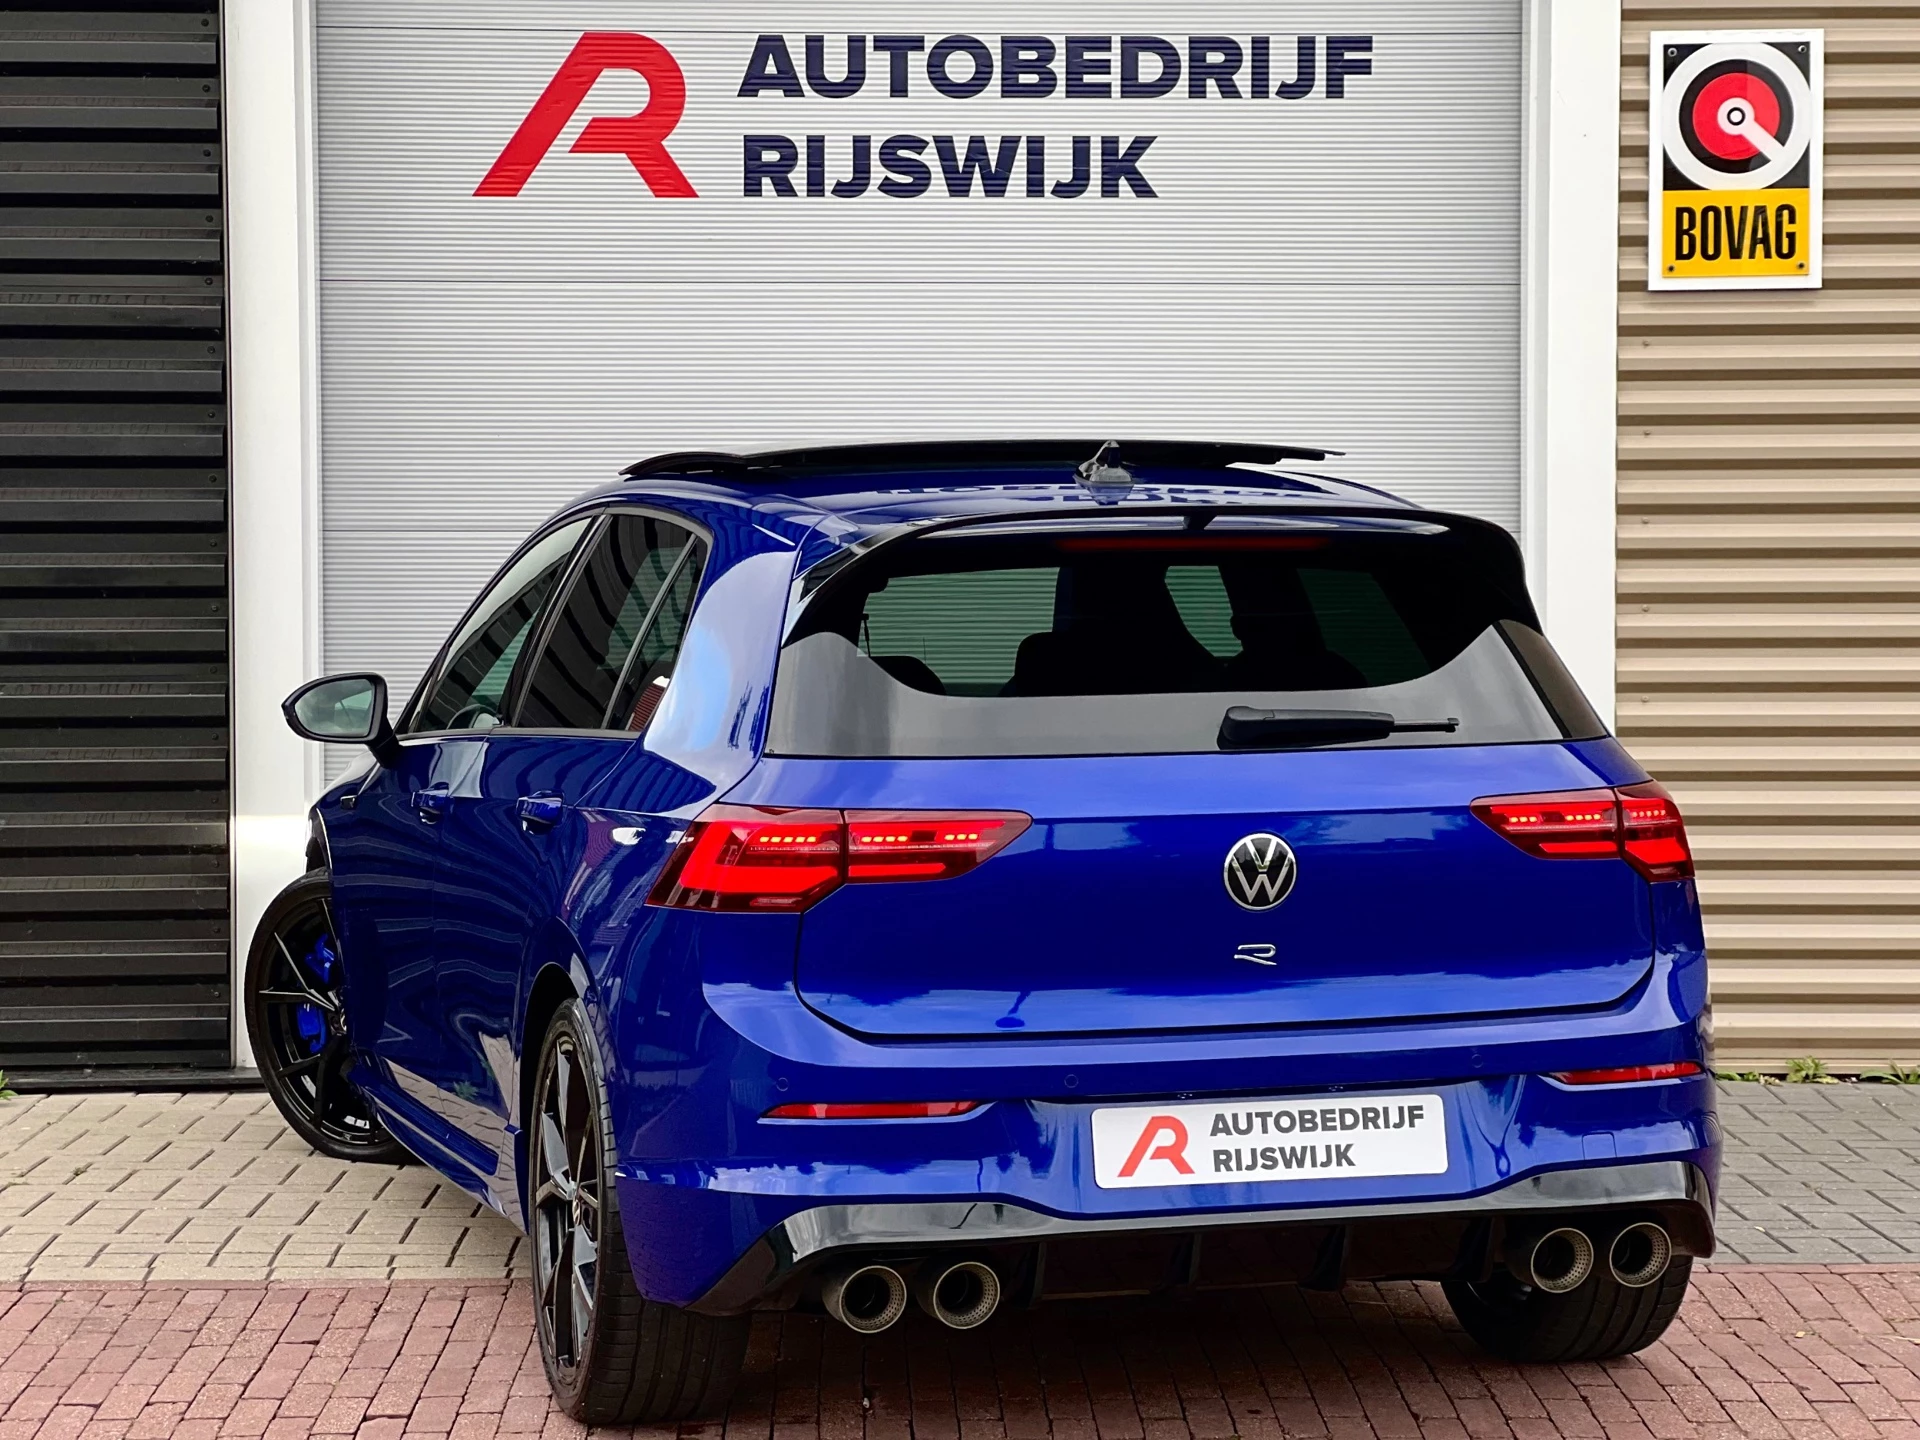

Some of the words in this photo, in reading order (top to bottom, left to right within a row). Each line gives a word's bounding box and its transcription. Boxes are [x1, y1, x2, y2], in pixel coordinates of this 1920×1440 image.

[737, 34, 1374, 99] AUTOBEDRIJF
[743, 134, 1158, 198] RIJSWIJK
[1675, 204, 1797, 261] BOVAG
[1210, 1105, 1425, 1137] AUTOBEDRIJF
[1213, 1143, 1356, 1173] RIJSWIJK
